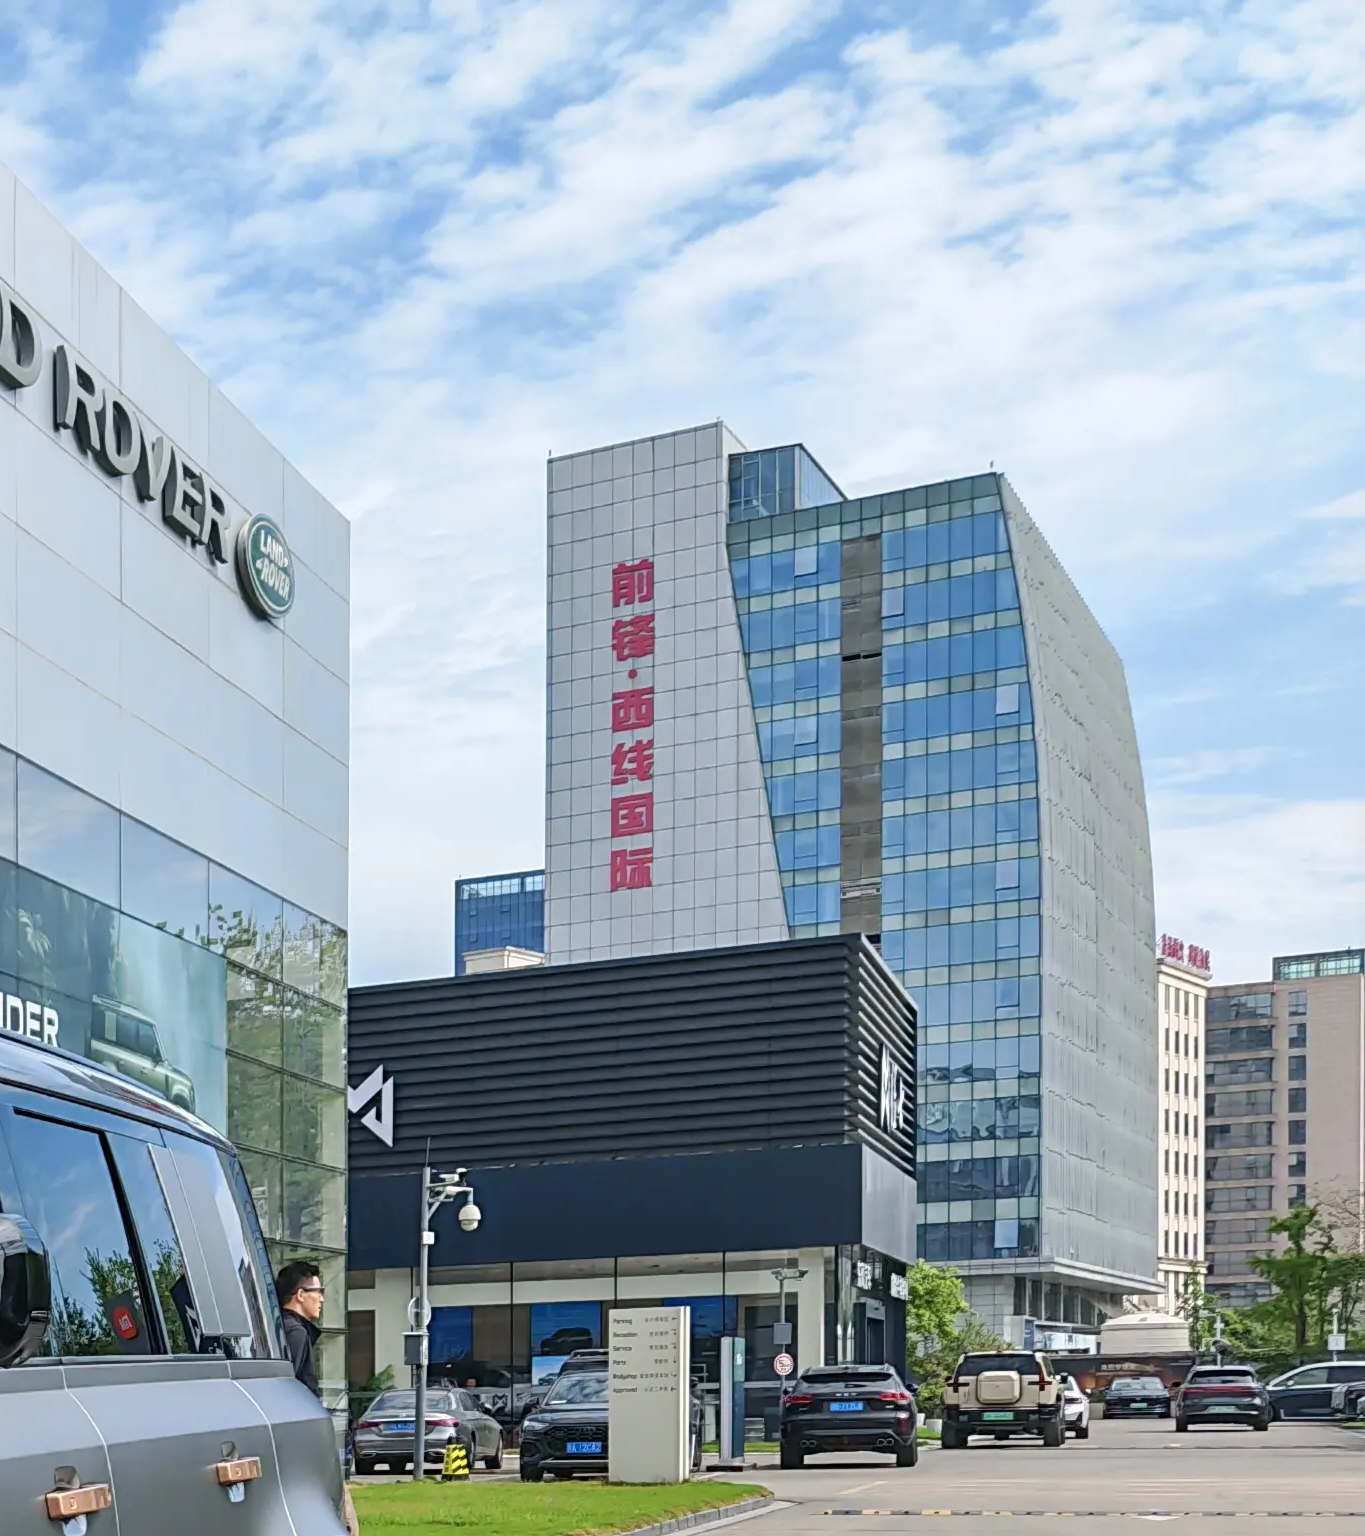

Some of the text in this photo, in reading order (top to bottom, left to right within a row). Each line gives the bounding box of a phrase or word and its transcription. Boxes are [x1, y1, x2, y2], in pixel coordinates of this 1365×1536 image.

[54, 344, 232, 565] ROVER
[259, 529, 285, 569] LAND
[260, 555, 291, 601] ROVER
[609, 557, 656, 894] 前锋·西线国际
